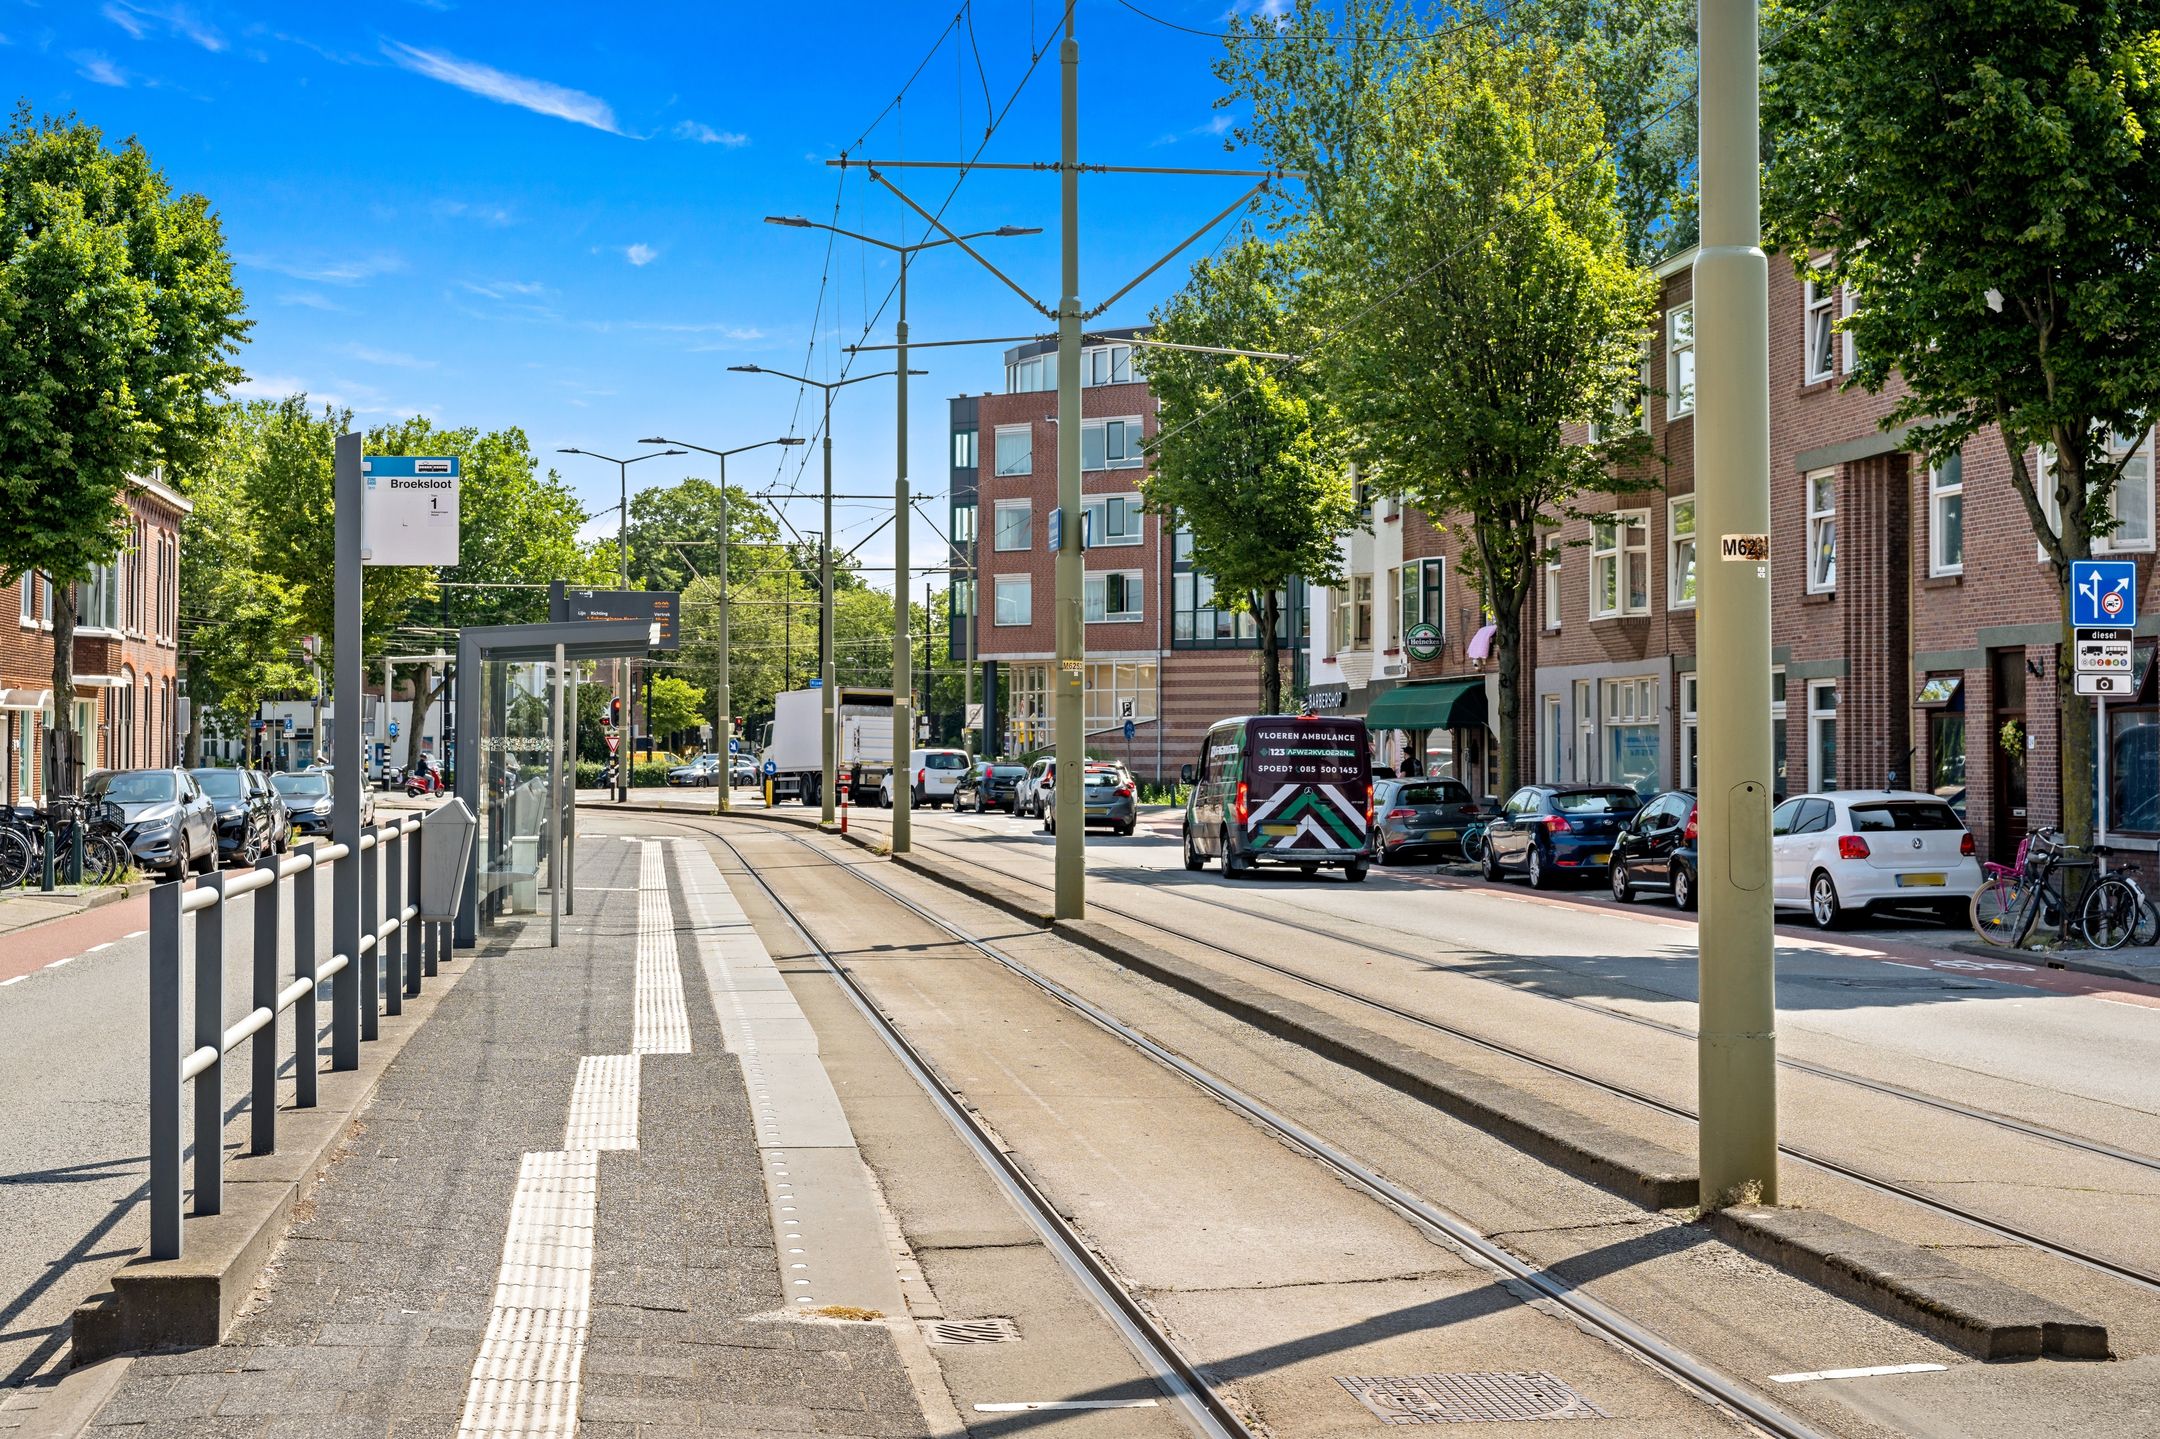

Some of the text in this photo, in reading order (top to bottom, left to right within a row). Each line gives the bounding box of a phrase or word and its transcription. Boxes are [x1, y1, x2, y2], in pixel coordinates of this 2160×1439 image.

[390, 479, 452, 489] Broeksloot
[430, 497, 437, 510] 1
[2091, 631, 2117, 639] diesel
[1308, 692, 1343, 709] BARBERSHOP
[1258, 732, 1355, 741] VLOEREN AMBULANCE
[1270, 748, 1285, 756] 123
[1258, 765, 1358, 774] SPOED? 085 500 1453
